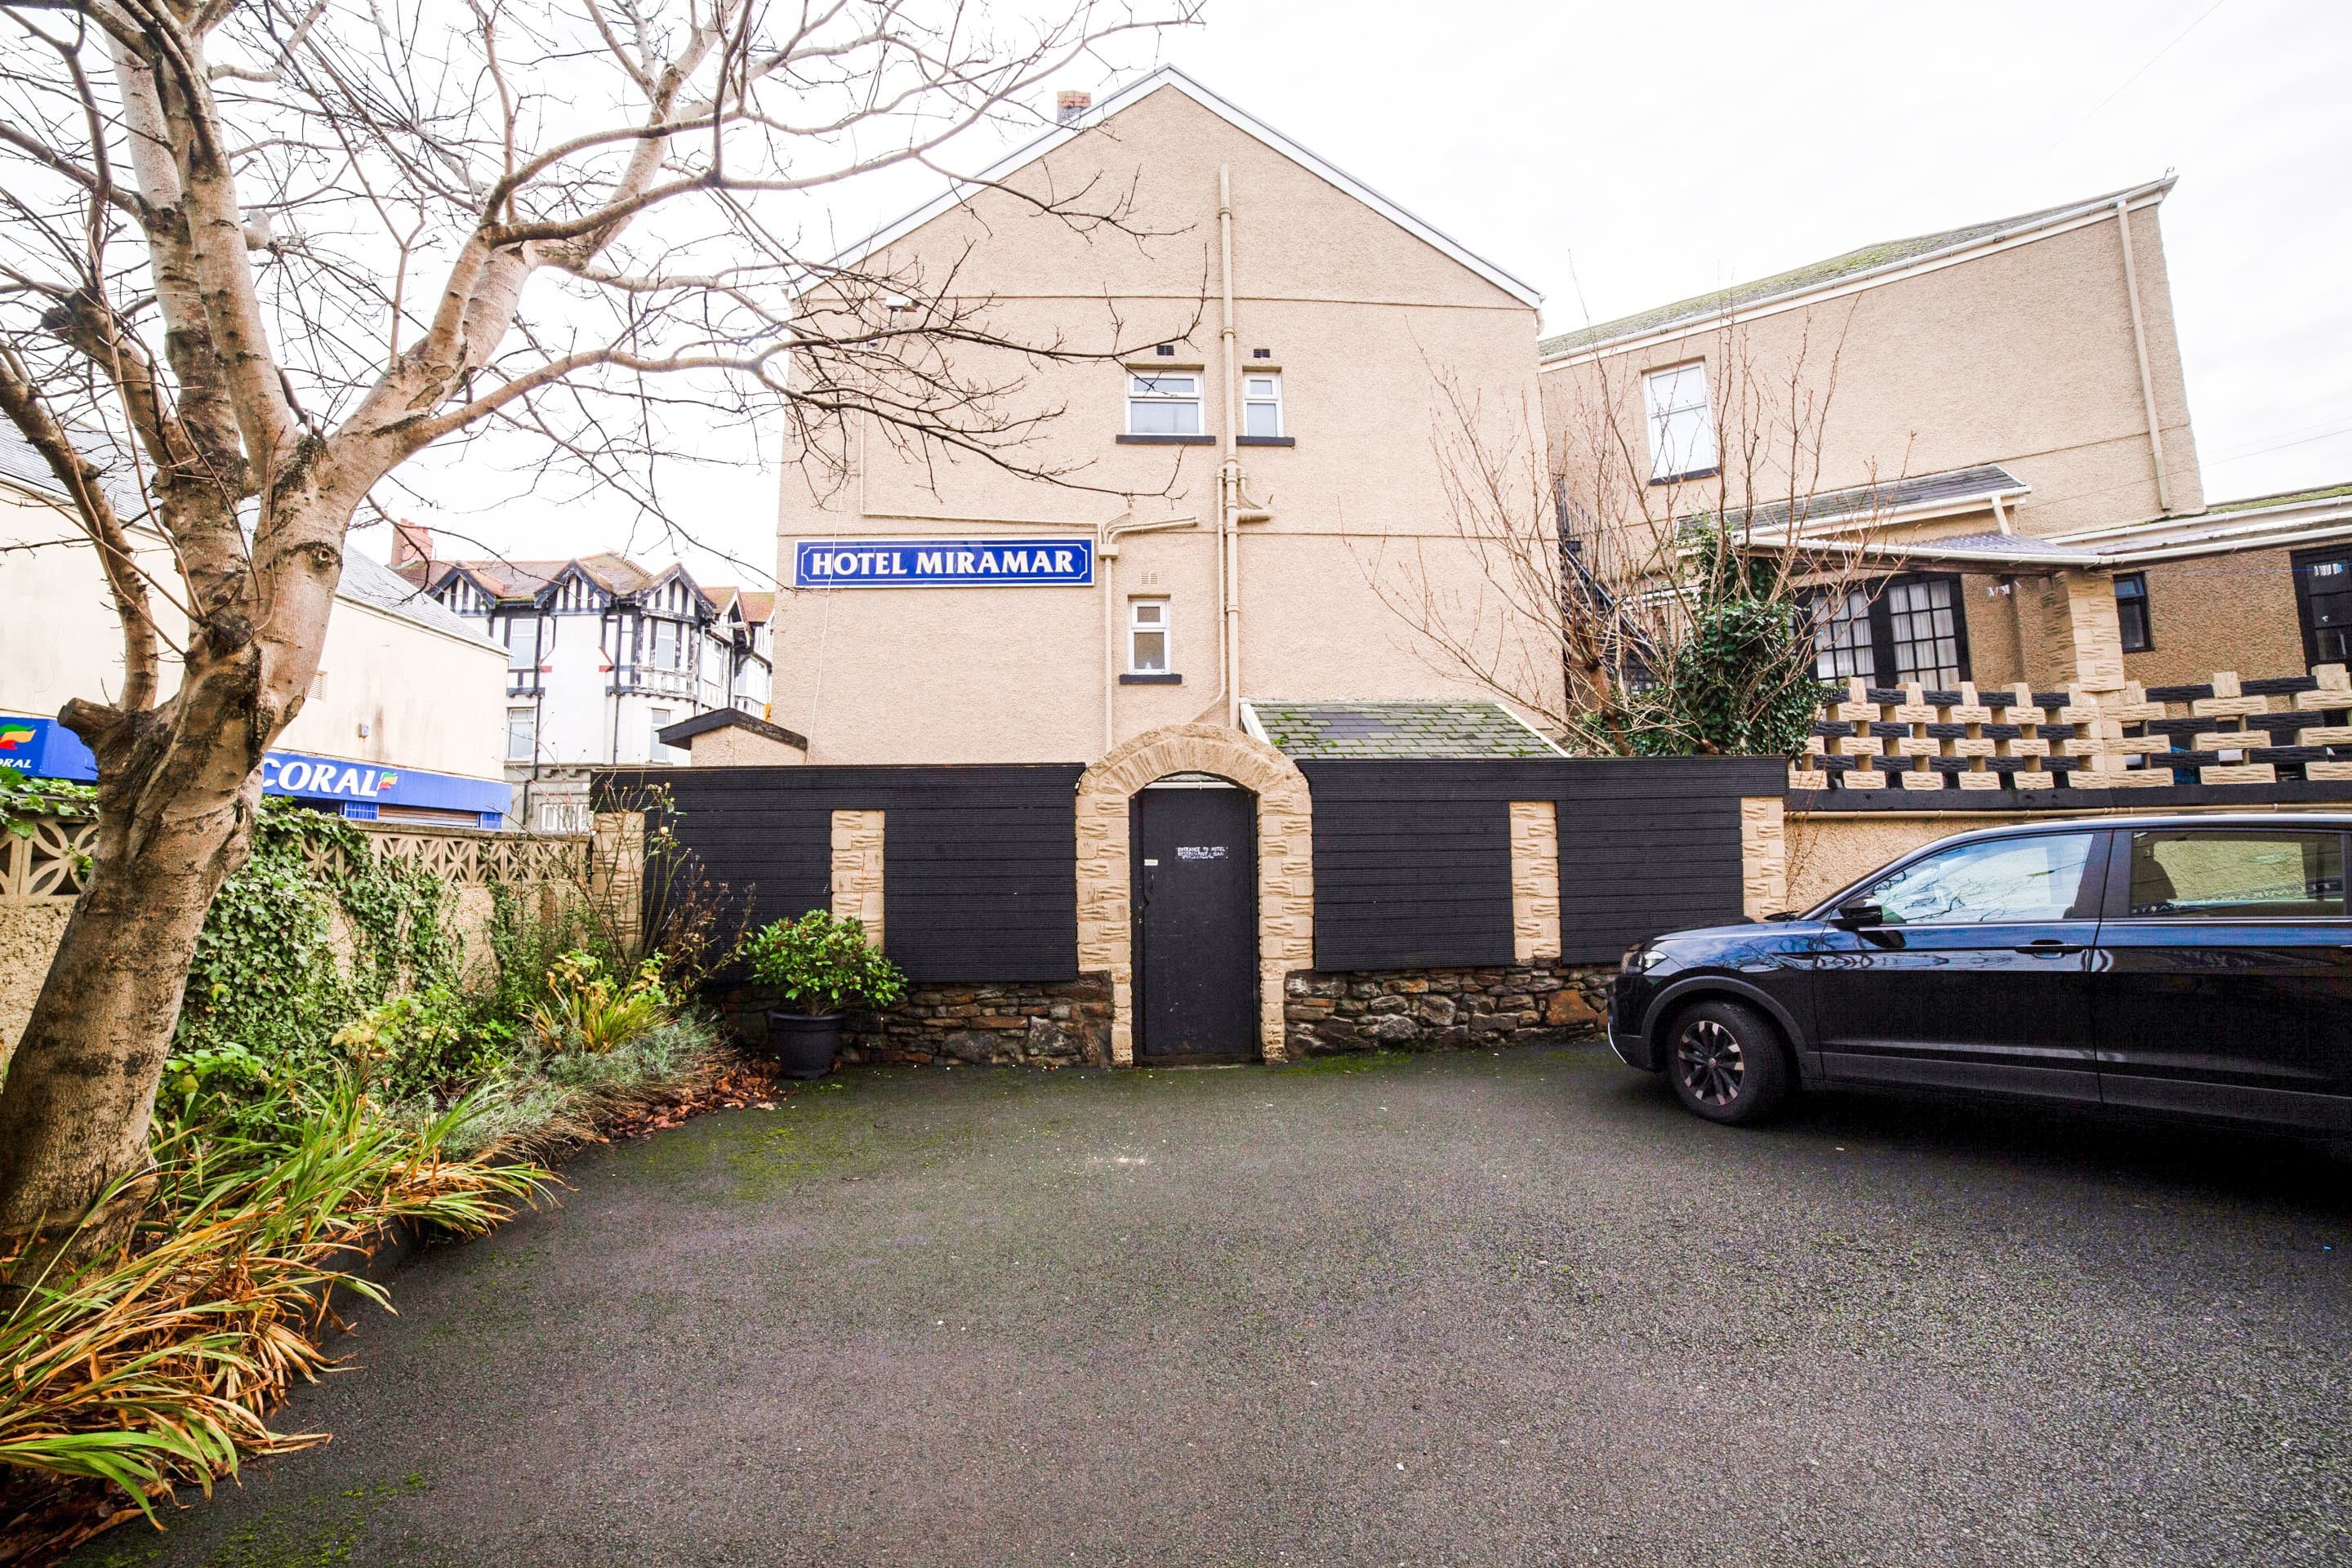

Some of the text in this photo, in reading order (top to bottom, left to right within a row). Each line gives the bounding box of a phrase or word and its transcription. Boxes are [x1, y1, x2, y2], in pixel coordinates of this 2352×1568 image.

[811, 550, 1075, 577] HOTEL MIRAMAR
[263, 758, 378, 797] CORAL
